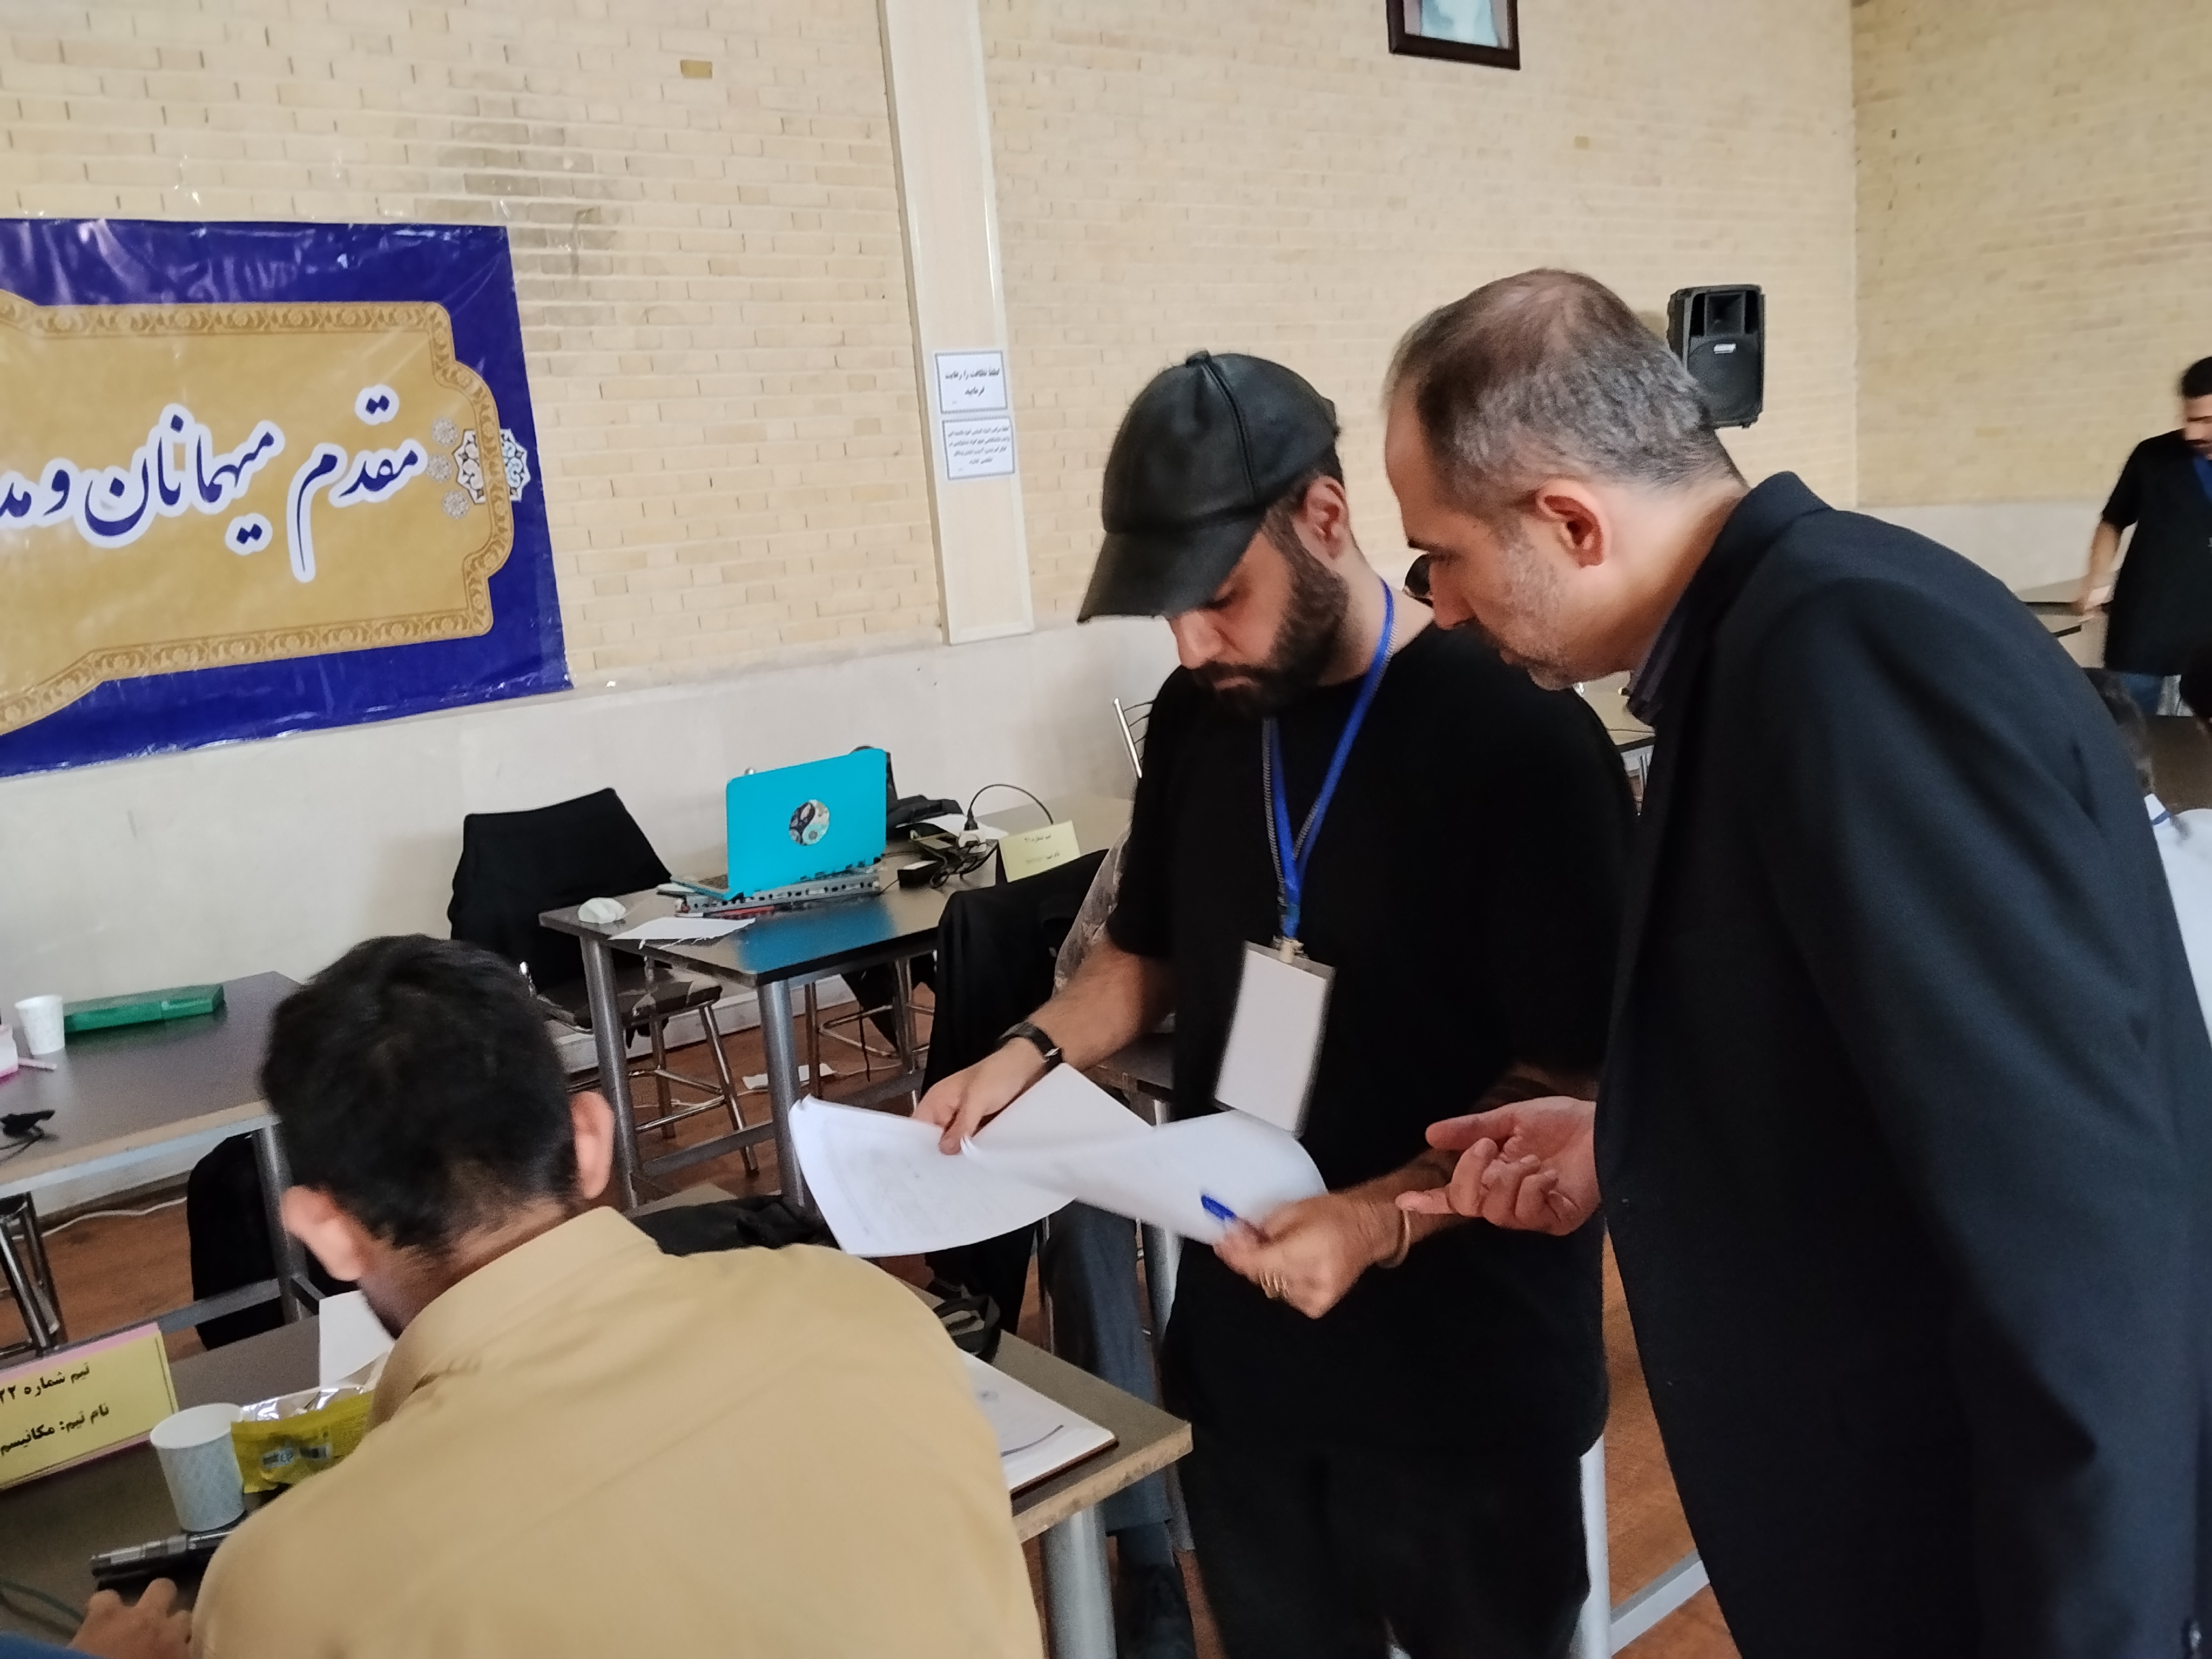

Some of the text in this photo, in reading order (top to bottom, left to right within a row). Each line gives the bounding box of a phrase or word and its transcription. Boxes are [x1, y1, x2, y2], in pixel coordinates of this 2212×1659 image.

[43, 469, 71, 517] و
[84, 414, 274, 544] میهمانان
[297, 394, 419, 572] مقدم
[24, 1372, 65, 1398] شماره
[70, 1362, 90, 1384] تیم
[0, 1402, 109, 1456] نام تیم: مکانیسم
